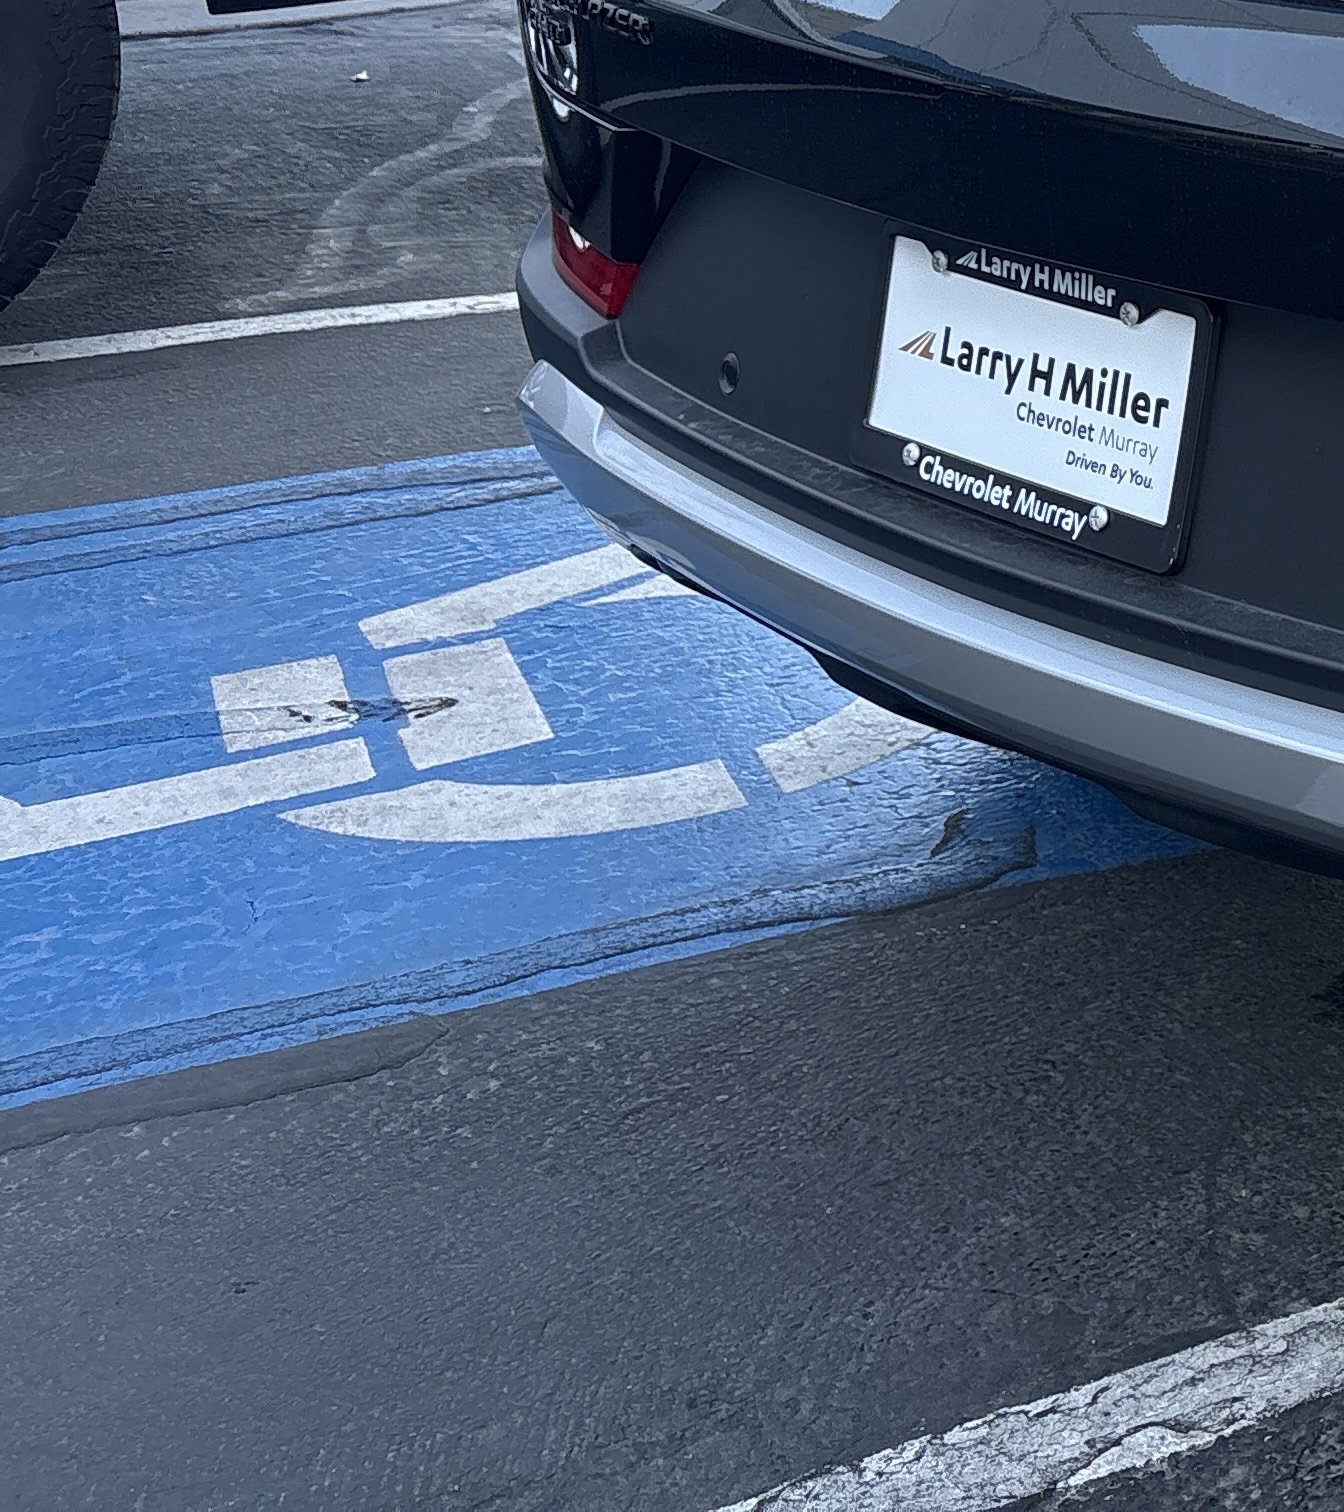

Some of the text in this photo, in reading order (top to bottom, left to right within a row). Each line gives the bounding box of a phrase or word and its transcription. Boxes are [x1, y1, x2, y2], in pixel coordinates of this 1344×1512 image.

[980, 248, 1117, 308] Larry H Miller
[940, 325, 1170, 429] Larry H Miller
[1016, 400, 1159, 466] Chevrolet Murray
[918, 454, 1090, 541] Chevrolet Murray
[1065, 449, 1107, 478] Driven
[1109, 463, 1128, 486] By
